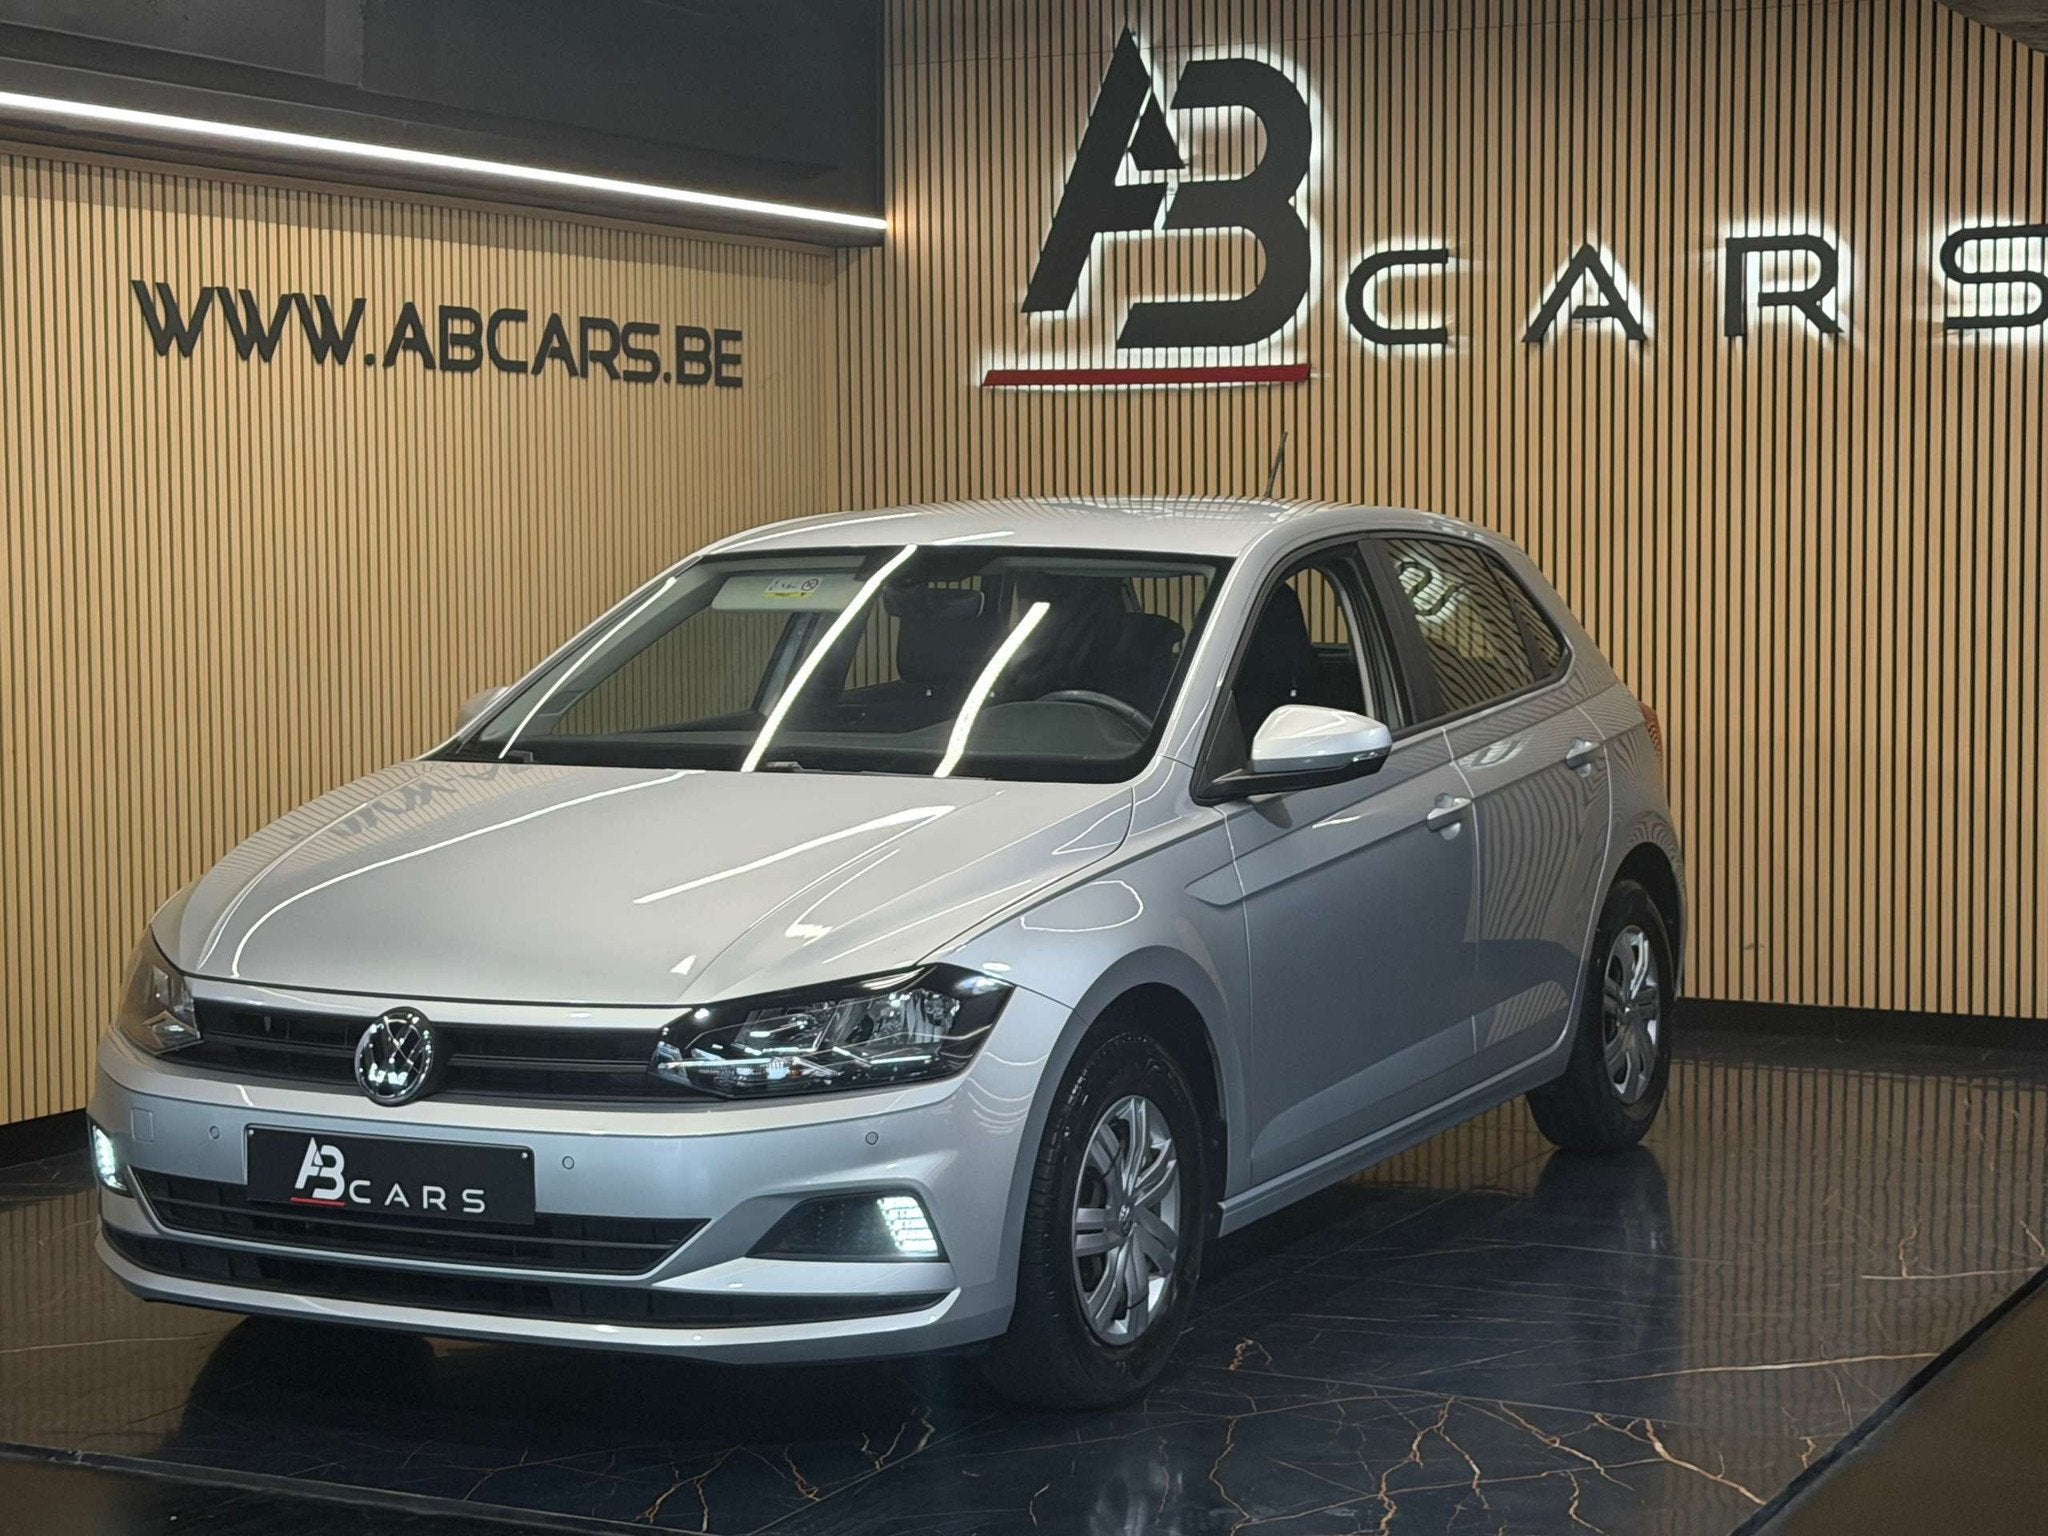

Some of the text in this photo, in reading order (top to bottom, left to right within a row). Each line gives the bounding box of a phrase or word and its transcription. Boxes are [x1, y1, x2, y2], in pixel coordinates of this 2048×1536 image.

[1021, 24, 2048, 349] AB CARS
[131, 279, 743, 388] WWW.ABCARS.BE
[294, 1136, 486, 1214] AB CARS
